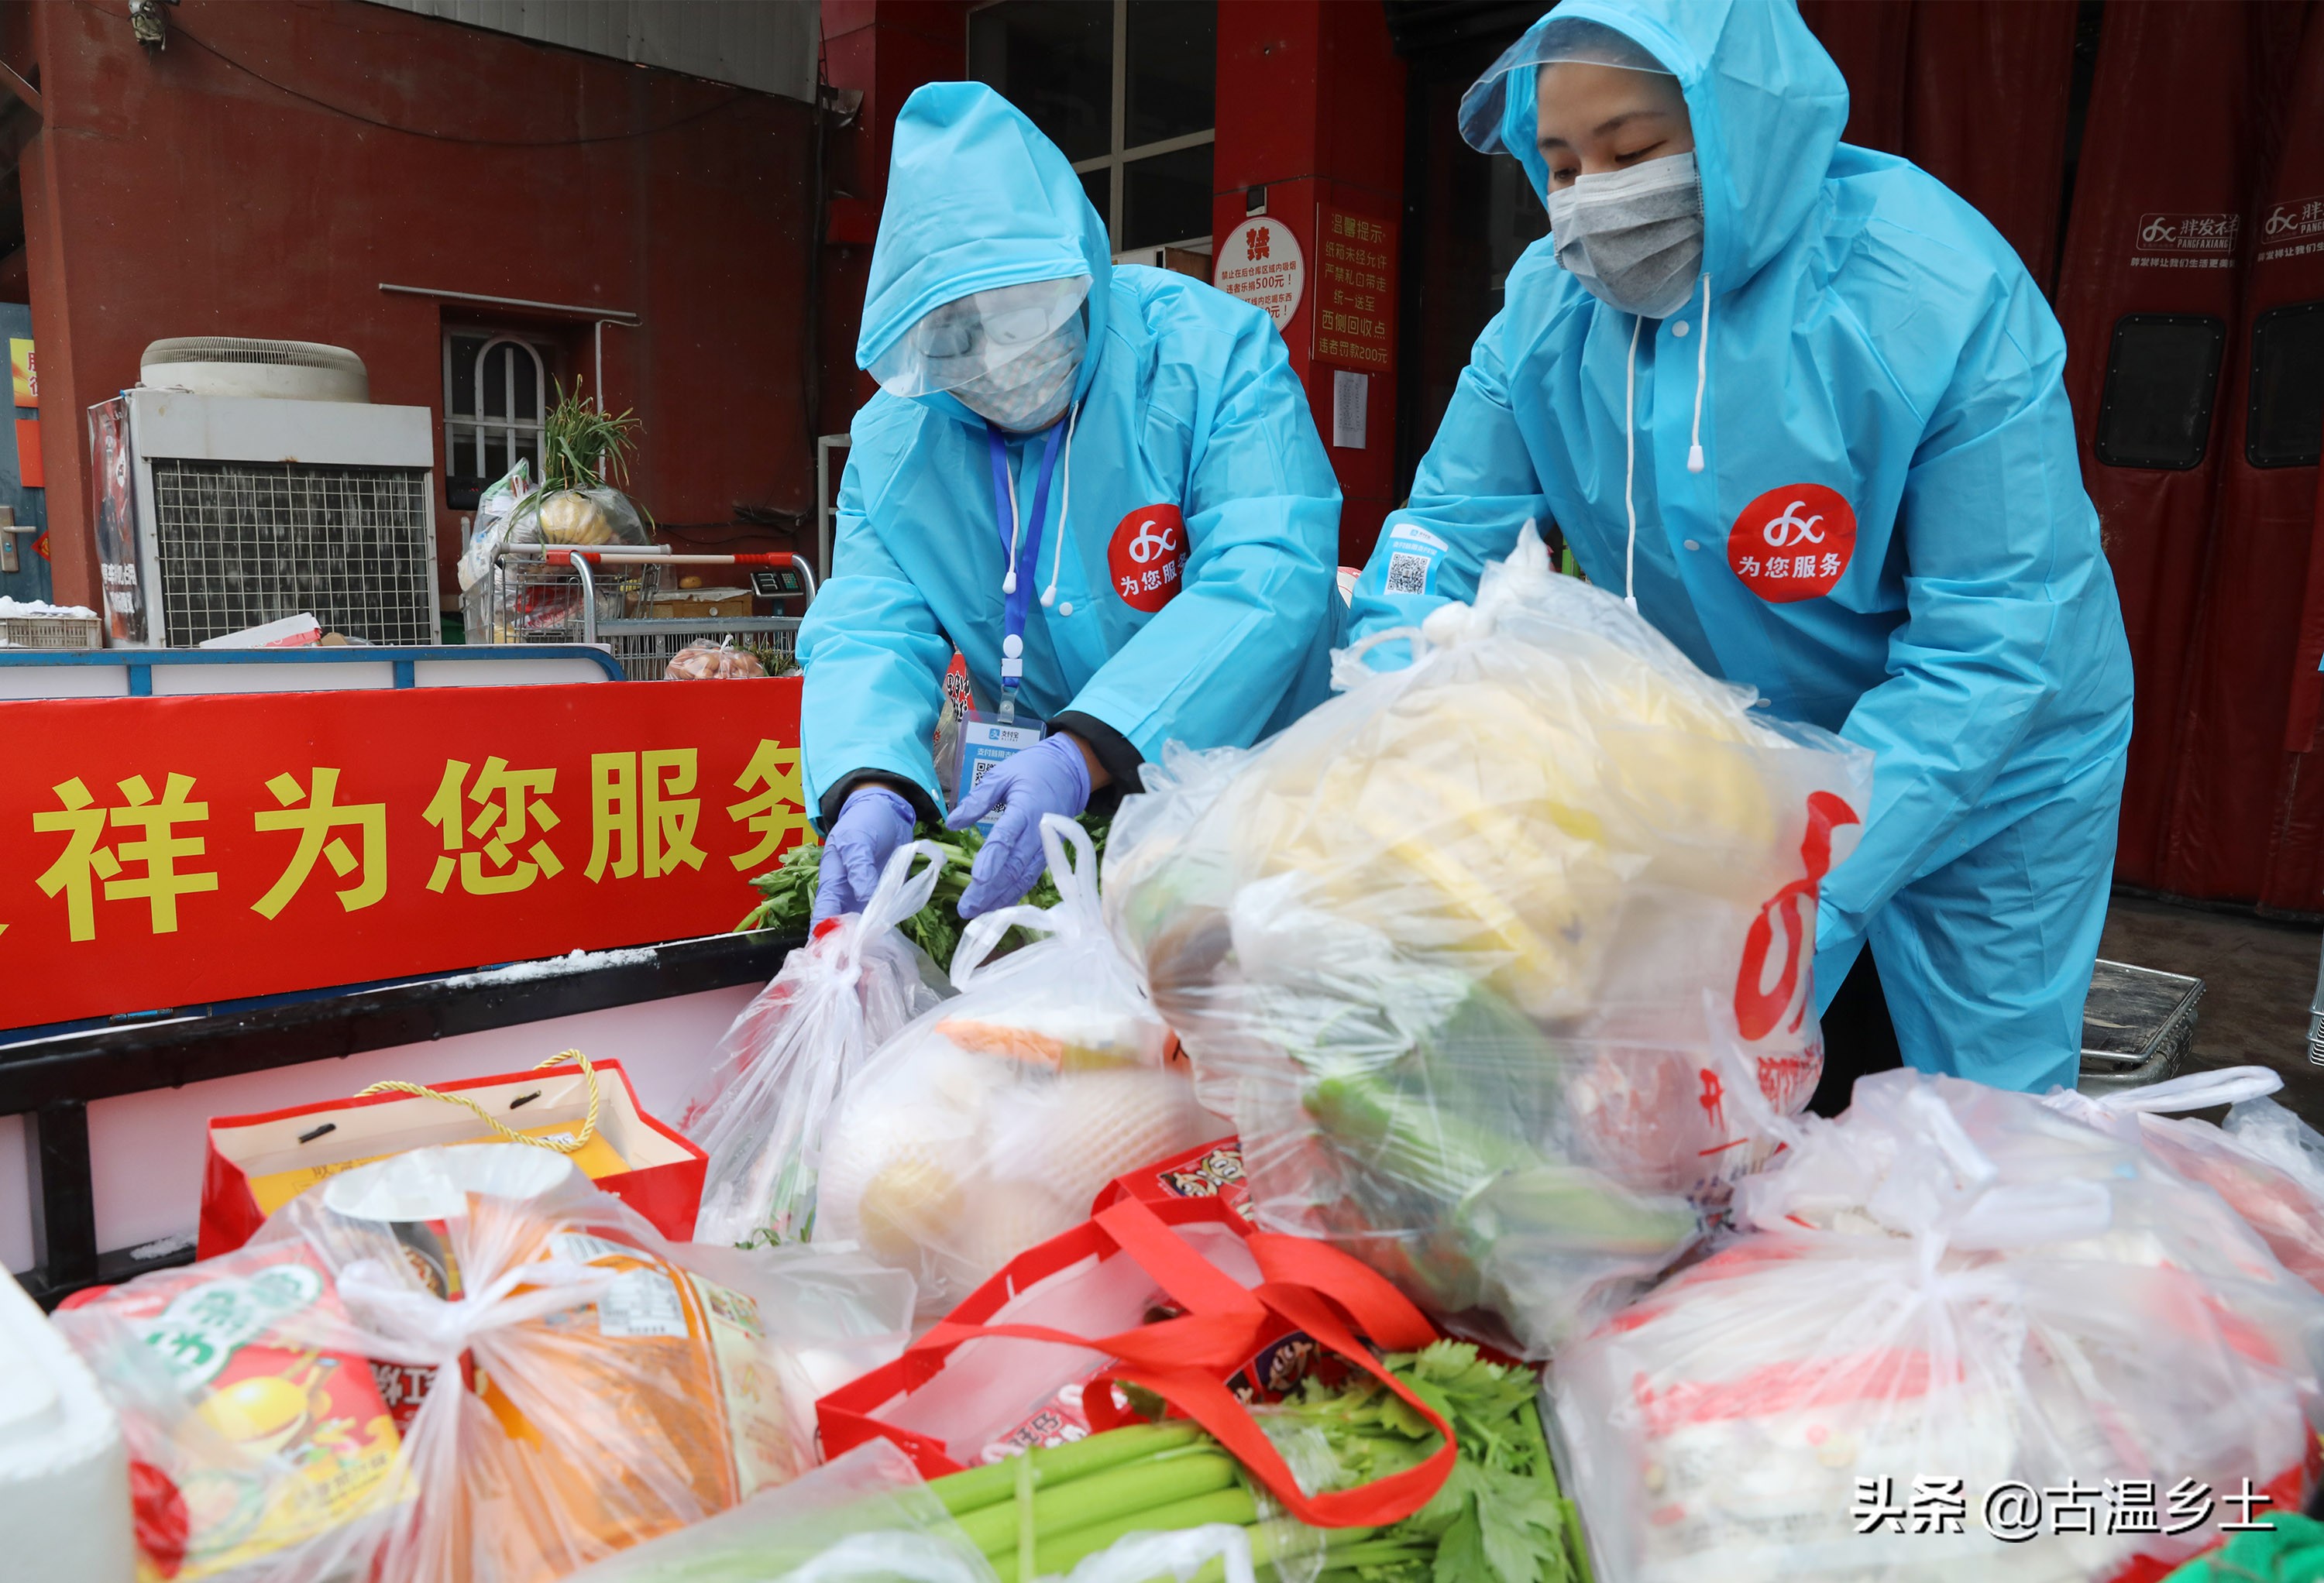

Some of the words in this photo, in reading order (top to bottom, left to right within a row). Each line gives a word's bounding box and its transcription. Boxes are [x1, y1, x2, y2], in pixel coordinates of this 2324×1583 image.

[2302, 200, 2324, 221] 胖
[1331, 213, 1383, 244] 温馨提示
[2180, 215, 2238, 255] 胖发祥
[1246, 226, 1270, 261] 禁
[1325, 241, 1388, 270] 纸箱未经允许
[2177, 239, 2229, 249] PANGFAXIANG
[1222, 261, 1297, 280] 禁止在后仓库区域内吸烟
[1324, 263, 1387, 292] 严禁私自带走
[1334, 288, 1376, 312] 统一送至
[1322, 310, 1386, 339] 西侧回收点
[1318, 337, 1388, 364] 违者罚款200元
[1120, 552, 1189, 598] 为您服务
[1738, 552, 1842, 579] 为您服务
[1001, 730, 1019, 739] 支付宝
[0, 738, 819, 942] 祥为您服务
